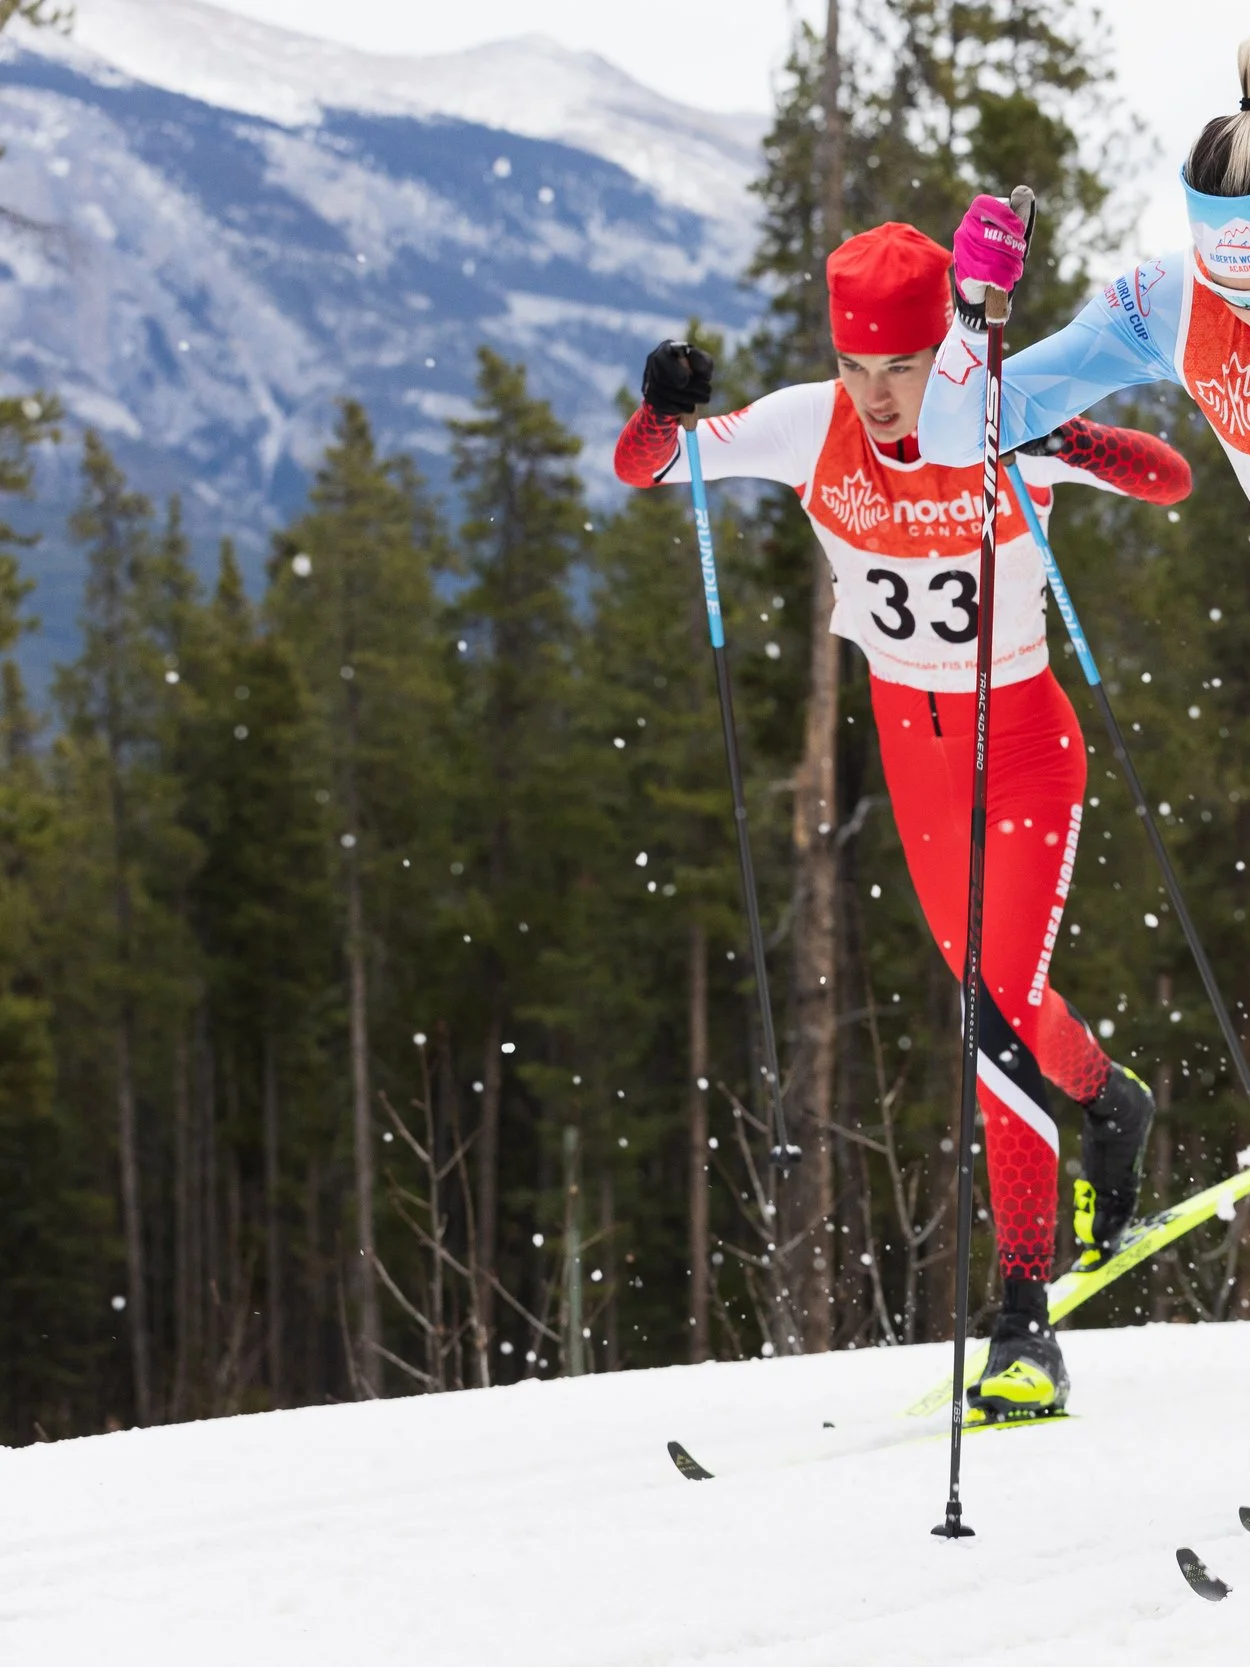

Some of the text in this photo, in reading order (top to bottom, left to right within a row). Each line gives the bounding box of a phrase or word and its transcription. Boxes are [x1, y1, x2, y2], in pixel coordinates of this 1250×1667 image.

[1210, 253, 1238, 264] ALBERTA
[1115, 276, 1149, 341] WORLD CUP
[908, 522, 983, 537] CANAD
[695, 507, 721, 616] RUNDLE
[866, 568, 979, 643] 33
[942, 661, 961, 670] FIS
[965, 651, 1015, 669] Reonal
[978, 671, 987, 714] TRIAC
[976, 731, 985, 771] AERO
[1027, 904, 1064, 1007] CHELSEA
[953, 1400, 962, 1424] TBS
